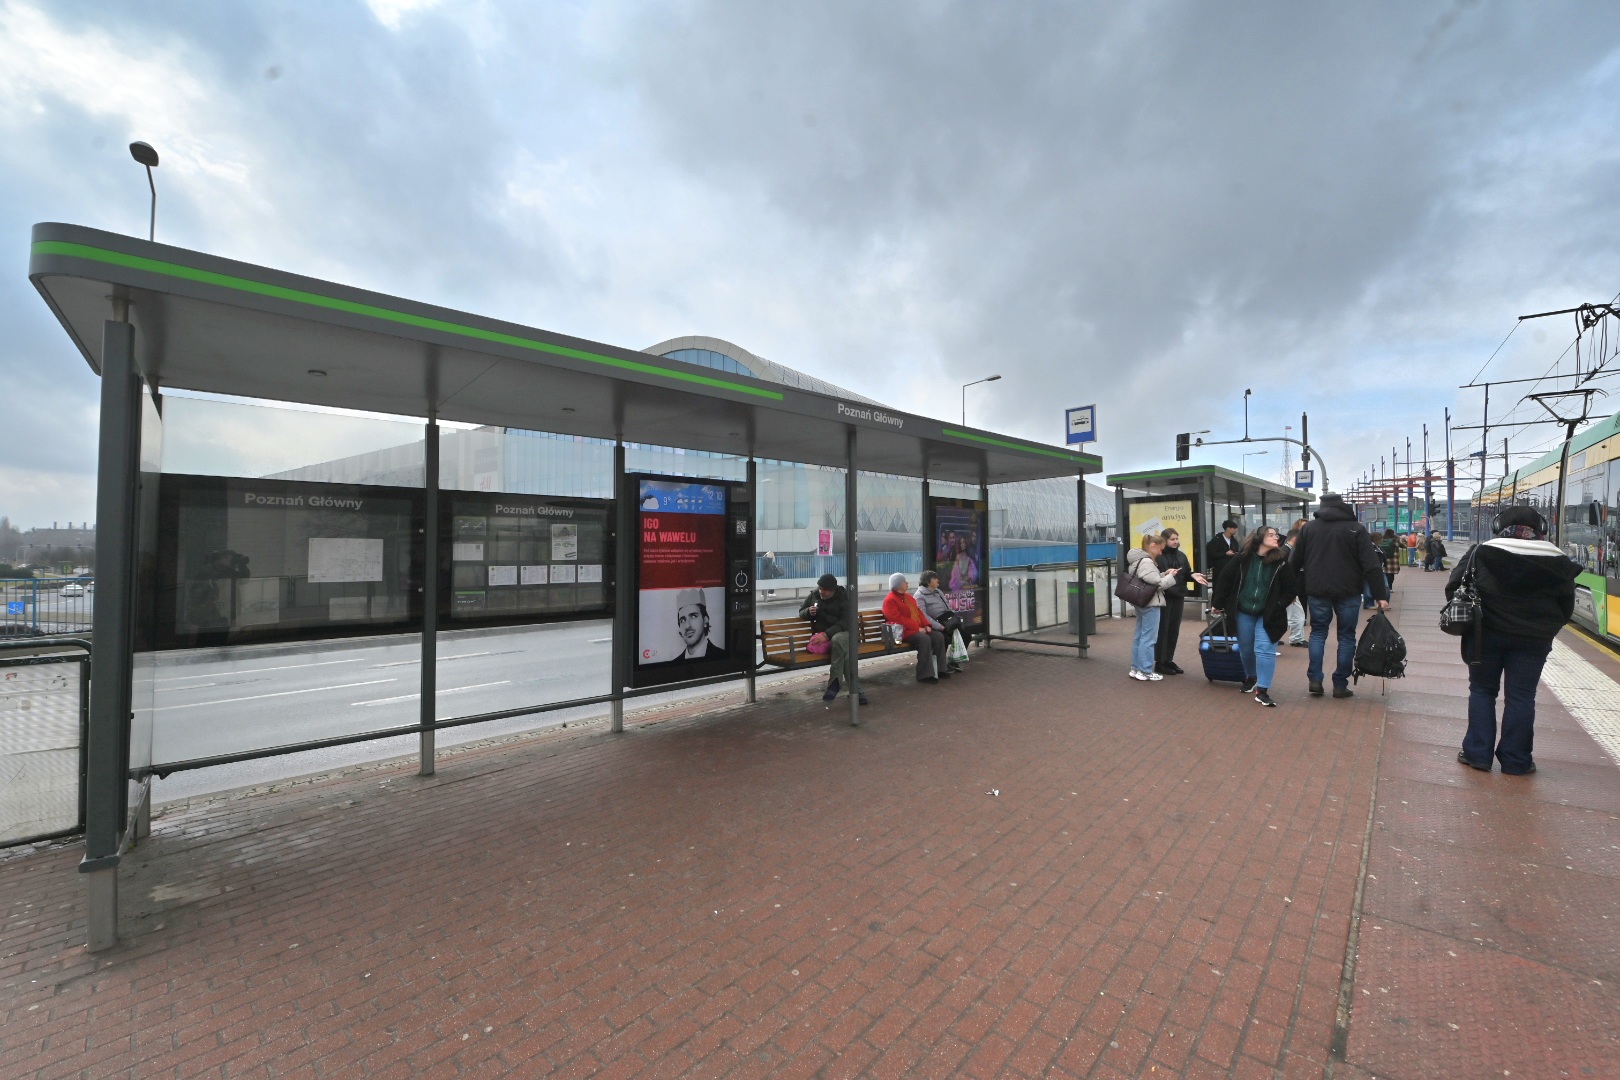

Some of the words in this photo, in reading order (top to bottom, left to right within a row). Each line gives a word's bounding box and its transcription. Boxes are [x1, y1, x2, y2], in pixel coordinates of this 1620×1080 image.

[837, 403, 872, 421] Poznań
[873, 411, 904, 429] Główny
[244, 493, 304, 506] Poznań
[308, 496, 363, 511] Główny
[495, 504, 535, 515] Poznań
[537, 506, 574, 518] Główny
[643, 518, 659, 530] IGO
[643, 531, 657, 543] NA
[659, 531, 697, 543] WAWELU
